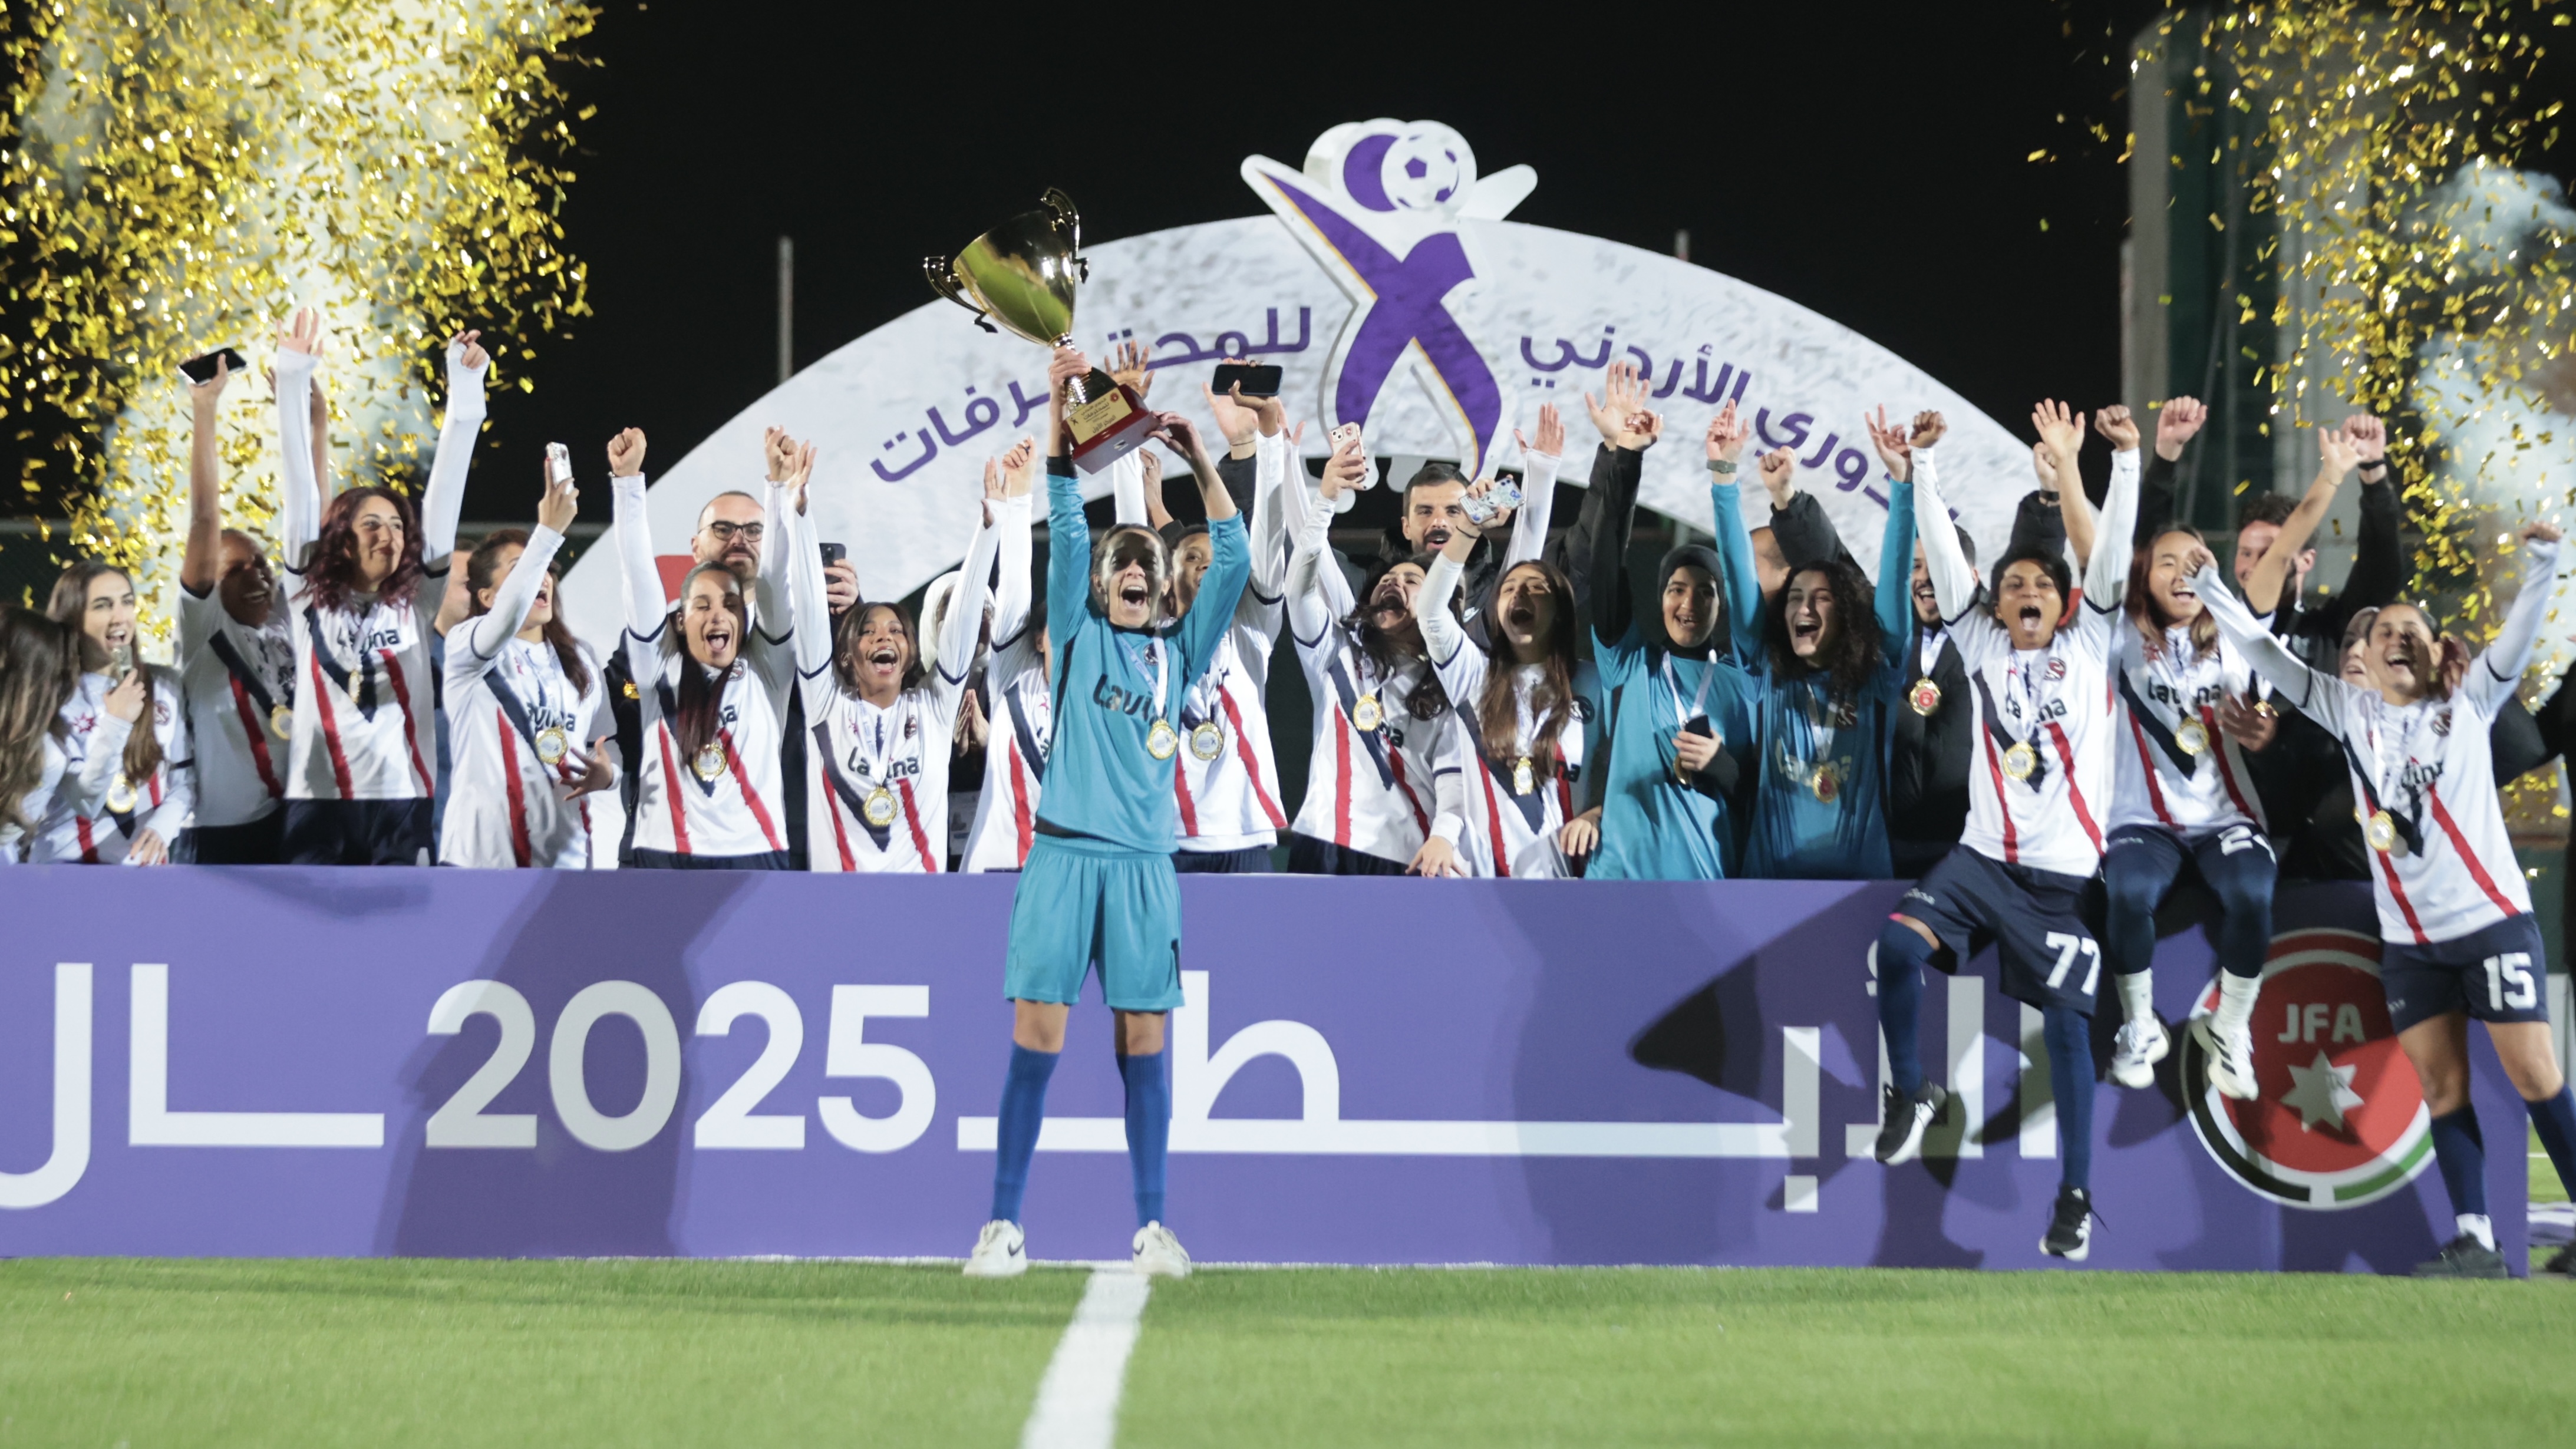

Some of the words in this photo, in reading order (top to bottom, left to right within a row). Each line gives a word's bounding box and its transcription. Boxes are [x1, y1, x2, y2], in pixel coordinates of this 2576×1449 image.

[1519, 325, 1751, 406] الأردني
[1093, 674, 1167, 727] Lavi
[847, 745, 921, 779] Laina
[2045, 931, 2101, 996] 77
[2483, 952, 2537, 1011] 15
[2277, 1003, 2366, 1044] JFA
[426, 979, 936, 1154] 2025
